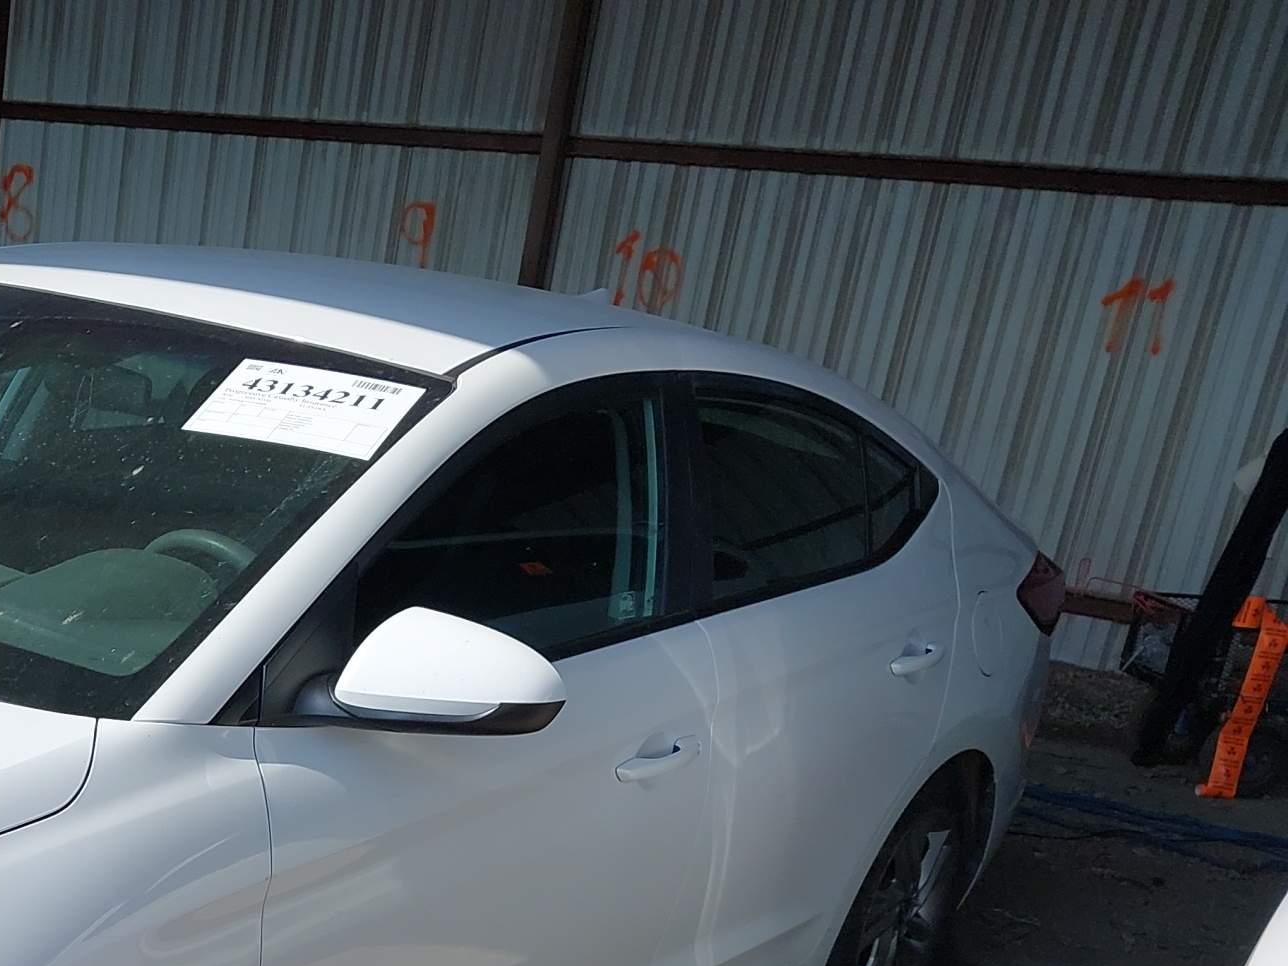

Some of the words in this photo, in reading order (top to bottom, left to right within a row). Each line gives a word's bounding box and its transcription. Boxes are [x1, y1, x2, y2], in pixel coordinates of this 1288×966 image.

[0, 164, 34, 242] 8
[403, 202, 436, 269] 9
[615, 229, 683, 318] 10
[1101, 276, 1176, 356] 11
[242, 377, 386, 410] 43134211
